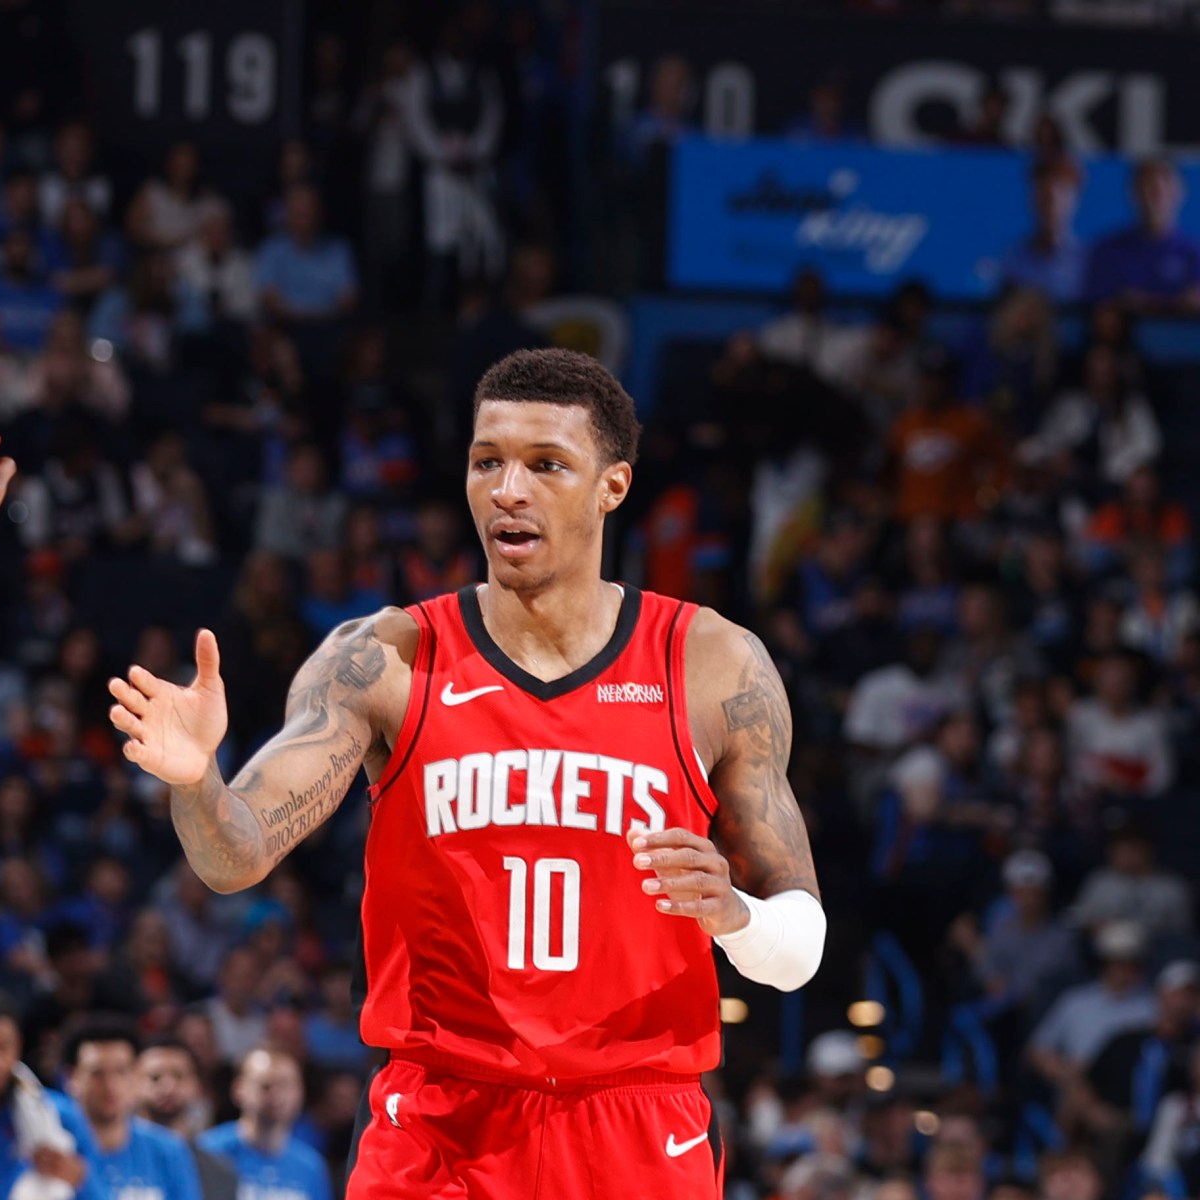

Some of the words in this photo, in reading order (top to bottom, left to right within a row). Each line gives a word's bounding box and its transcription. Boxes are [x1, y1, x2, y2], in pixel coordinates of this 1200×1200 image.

[125, 28, 278, 126] 119
[604, 57, 757, 142] 10
[596, 681, 663, 695] MEMORIAL
[597, 691, 664, 703] HERMANN
[260, 769, 333, 829] Complacency
[423, 748, 669, 838] ROCKETS
[502, 856, 581, 972] 10
